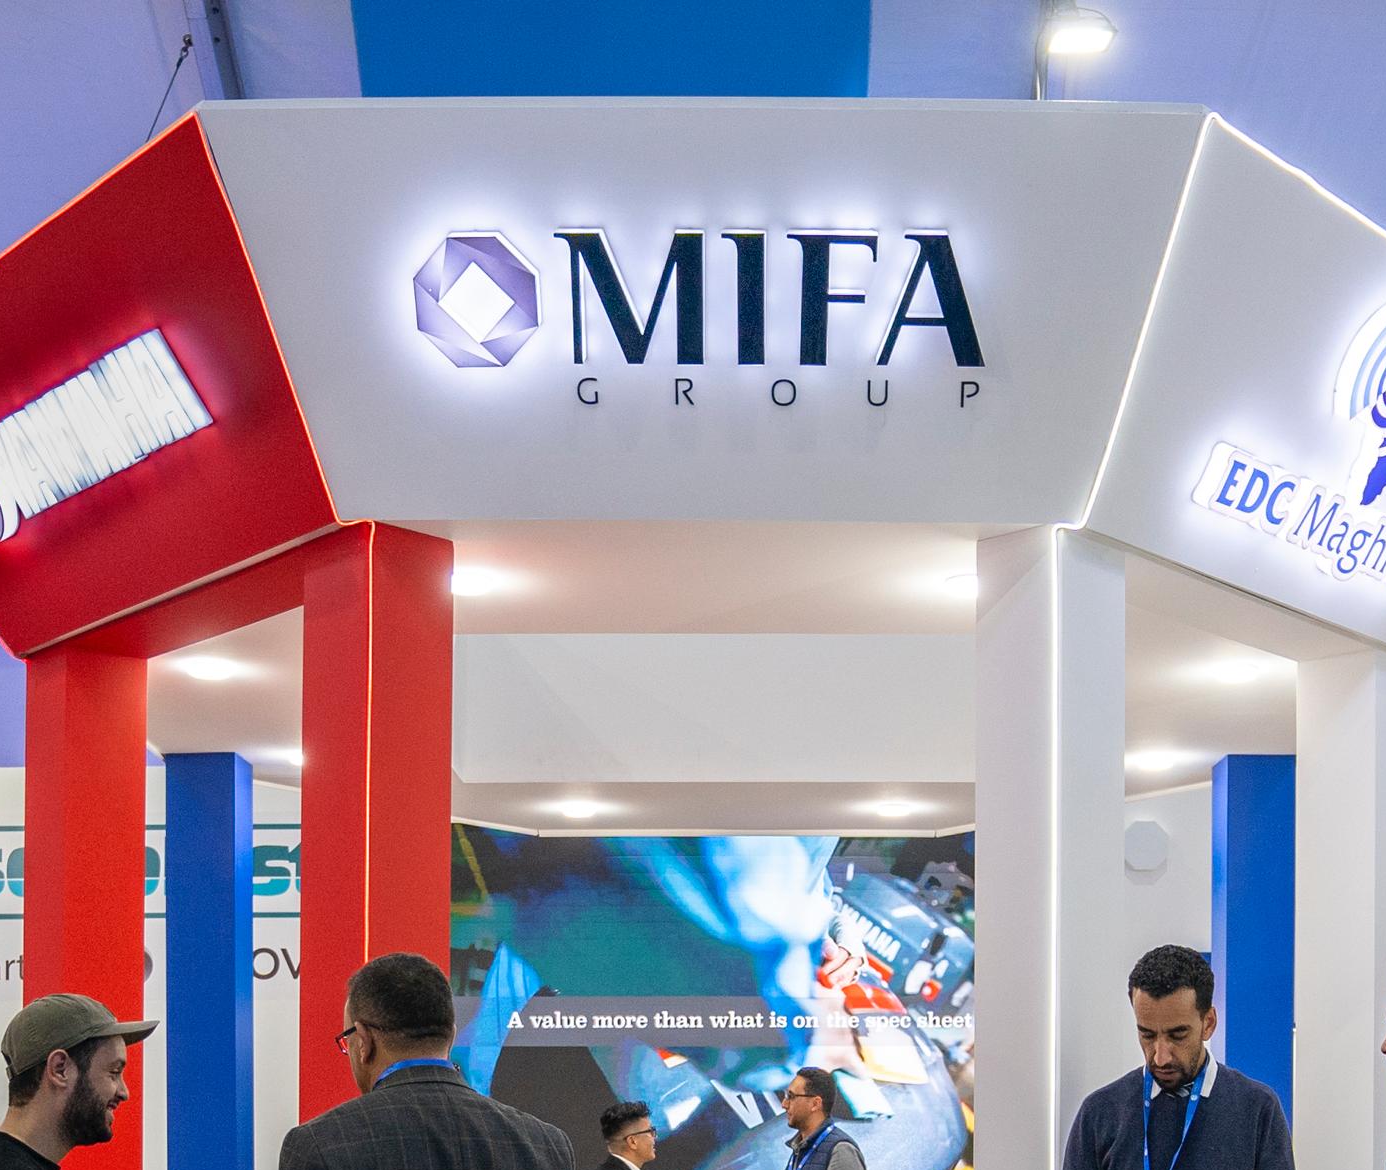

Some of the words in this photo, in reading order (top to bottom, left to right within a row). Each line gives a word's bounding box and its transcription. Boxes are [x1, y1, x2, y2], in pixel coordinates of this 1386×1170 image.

[553, 227, 986, 367] MIFA
[576, 377, 981, 408] GROUP
[1215, 459, 1297, 525] EDC
[507, 1011, 524, 1029] A
[530, 1010, 587, 1029] value
[592, 1014, 648, 1029] more
[654, 1010, 703, 1029] than
[709, 1010, 764, 1029] what
[769, 1010, 787, 1029] is
[793, 1014, 819, 1029] on
[826, 1010, 860, 1029] the
[865, 1014, 912, 1035] spec
[917, 1010, 973, 1029] sheet
